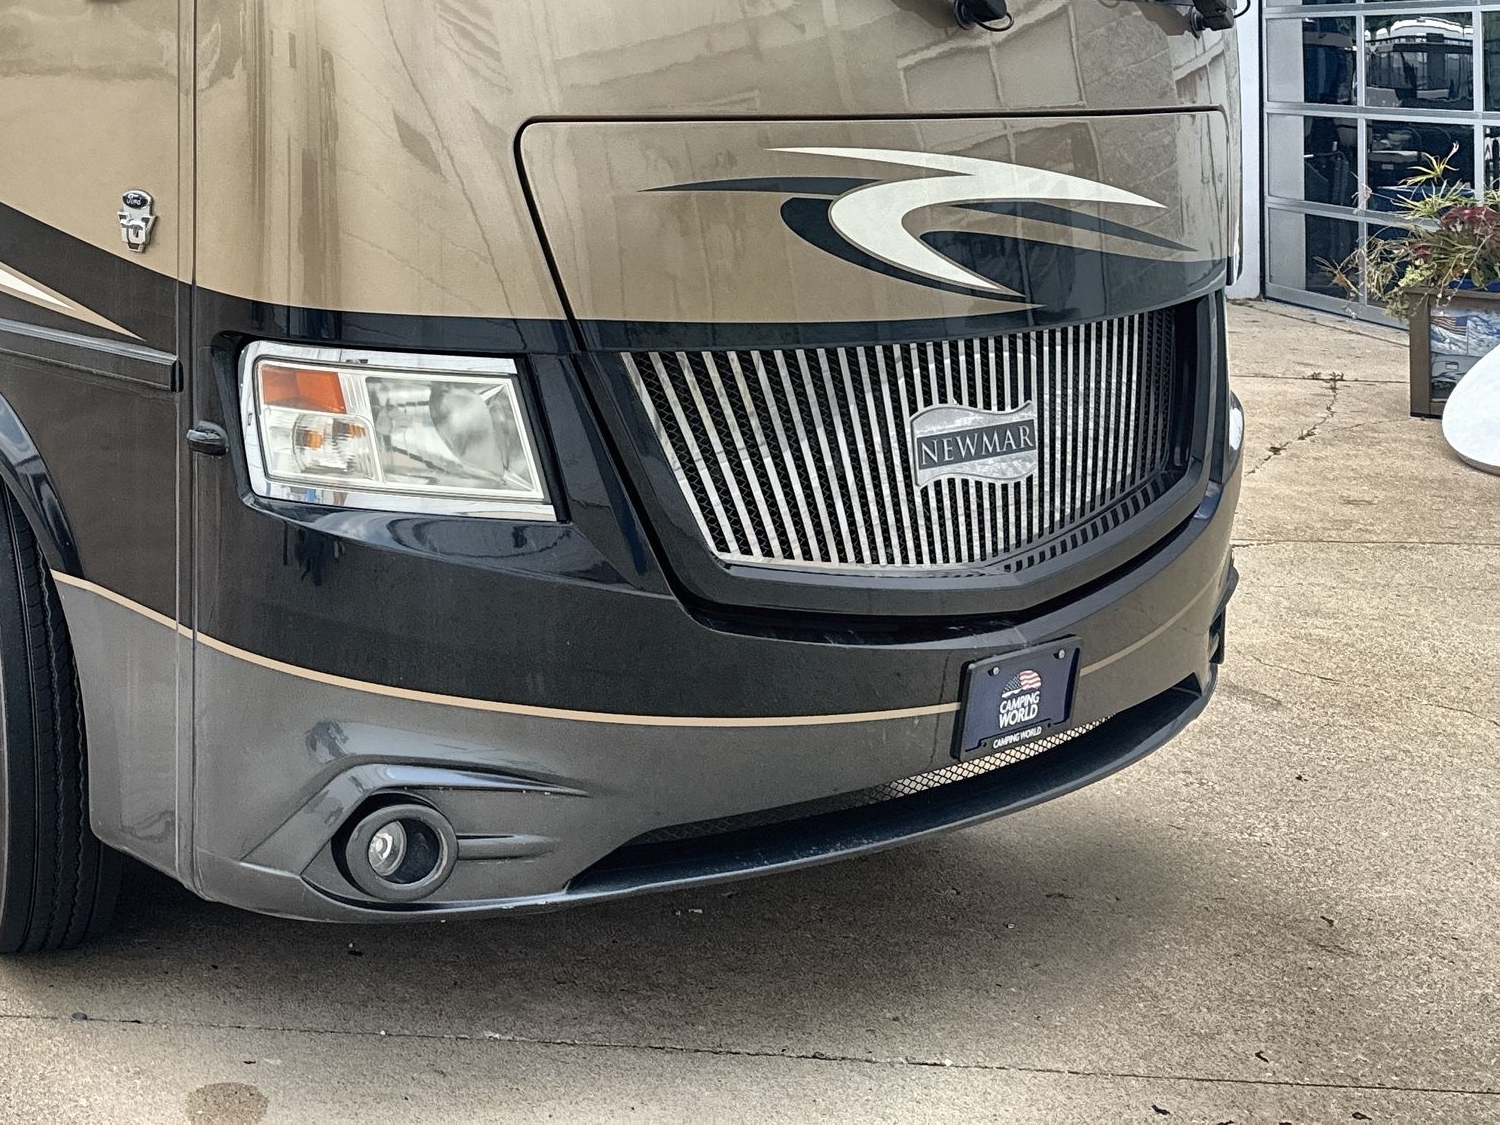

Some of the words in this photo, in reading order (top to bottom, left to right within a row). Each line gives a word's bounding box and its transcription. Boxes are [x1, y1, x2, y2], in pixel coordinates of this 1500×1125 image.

[920, 425, 1034, 465] NEWMAR
[999, 691, 1040, 714] CAMPING
[999, 704, 1039, 729] WORLD
[993, 732, 1020, 749] CAMPING
[1020, 726, 1042, 741] WORLD
